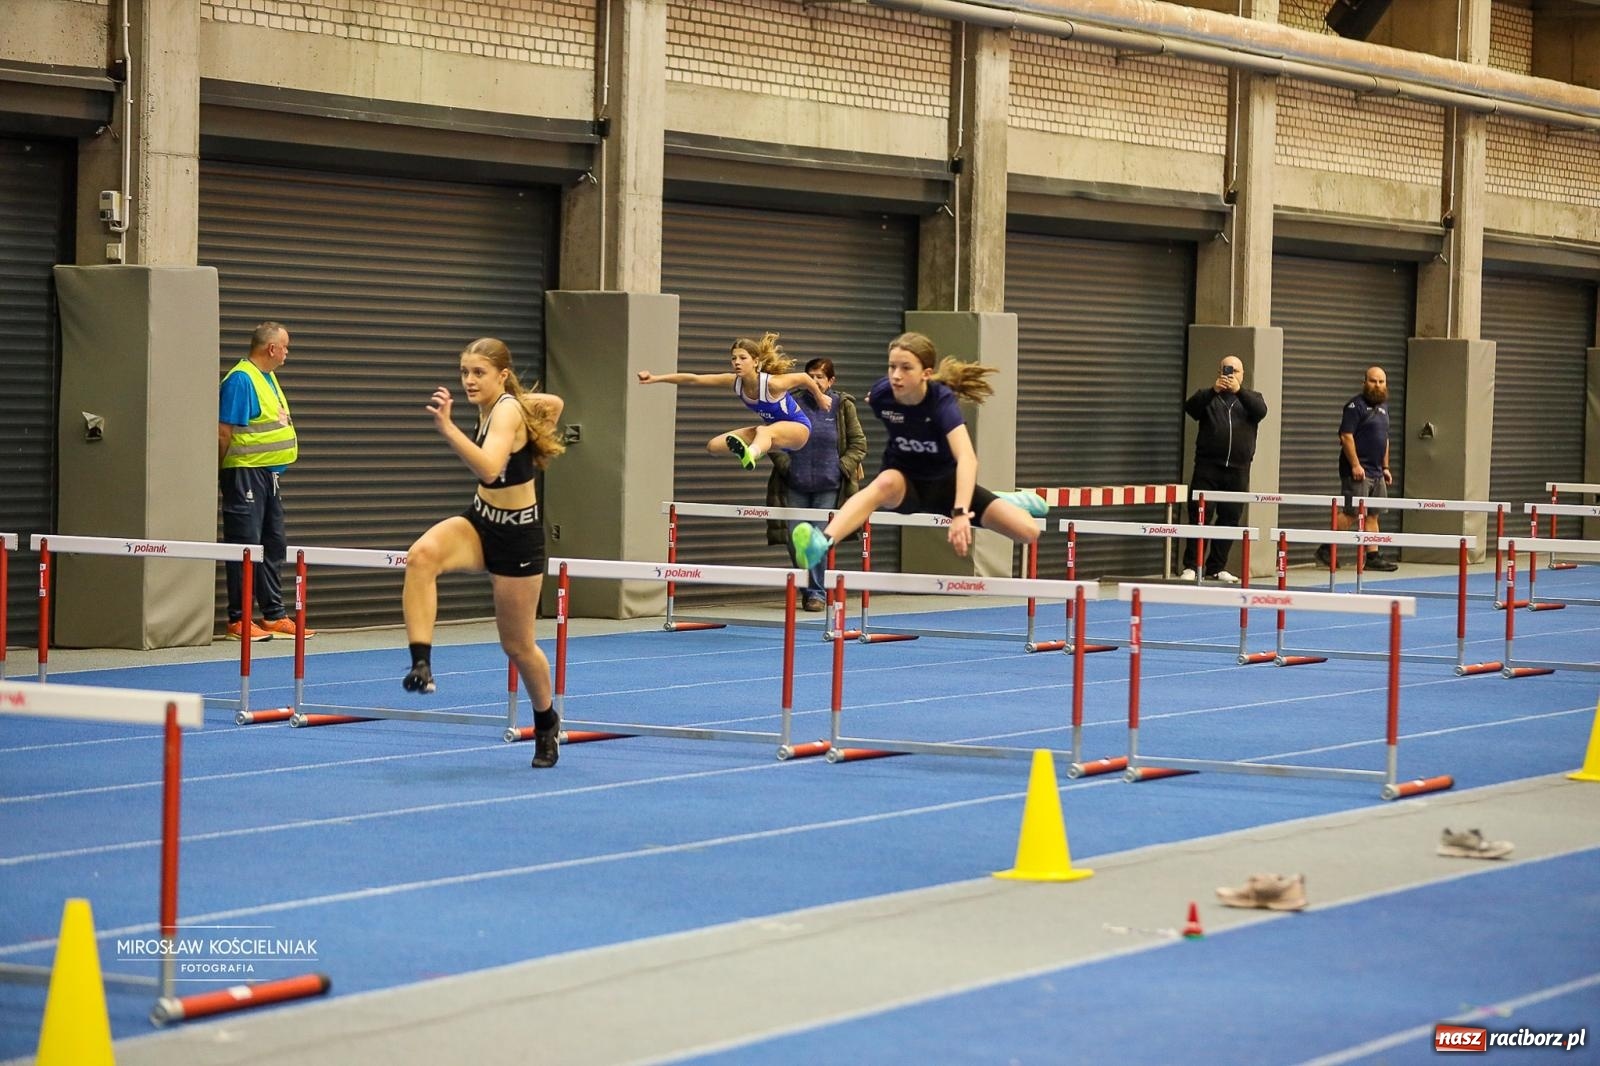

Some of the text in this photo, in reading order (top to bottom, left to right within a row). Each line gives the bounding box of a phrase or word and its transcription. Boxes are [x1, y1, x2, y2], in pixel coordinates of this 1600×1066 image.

[895, 436, 938, 453] 203
[743, 507, 769, 517] polanik
[1149, 525, 1178, 535] polanik
[1363, 534, 1393, 544] polanik
[134, 543, 167, 554] polanik
[664, 568, 701, 579] polanik
[947, 580, 987, 592] polanik
[1251, 594, 1293, 606] polanik
